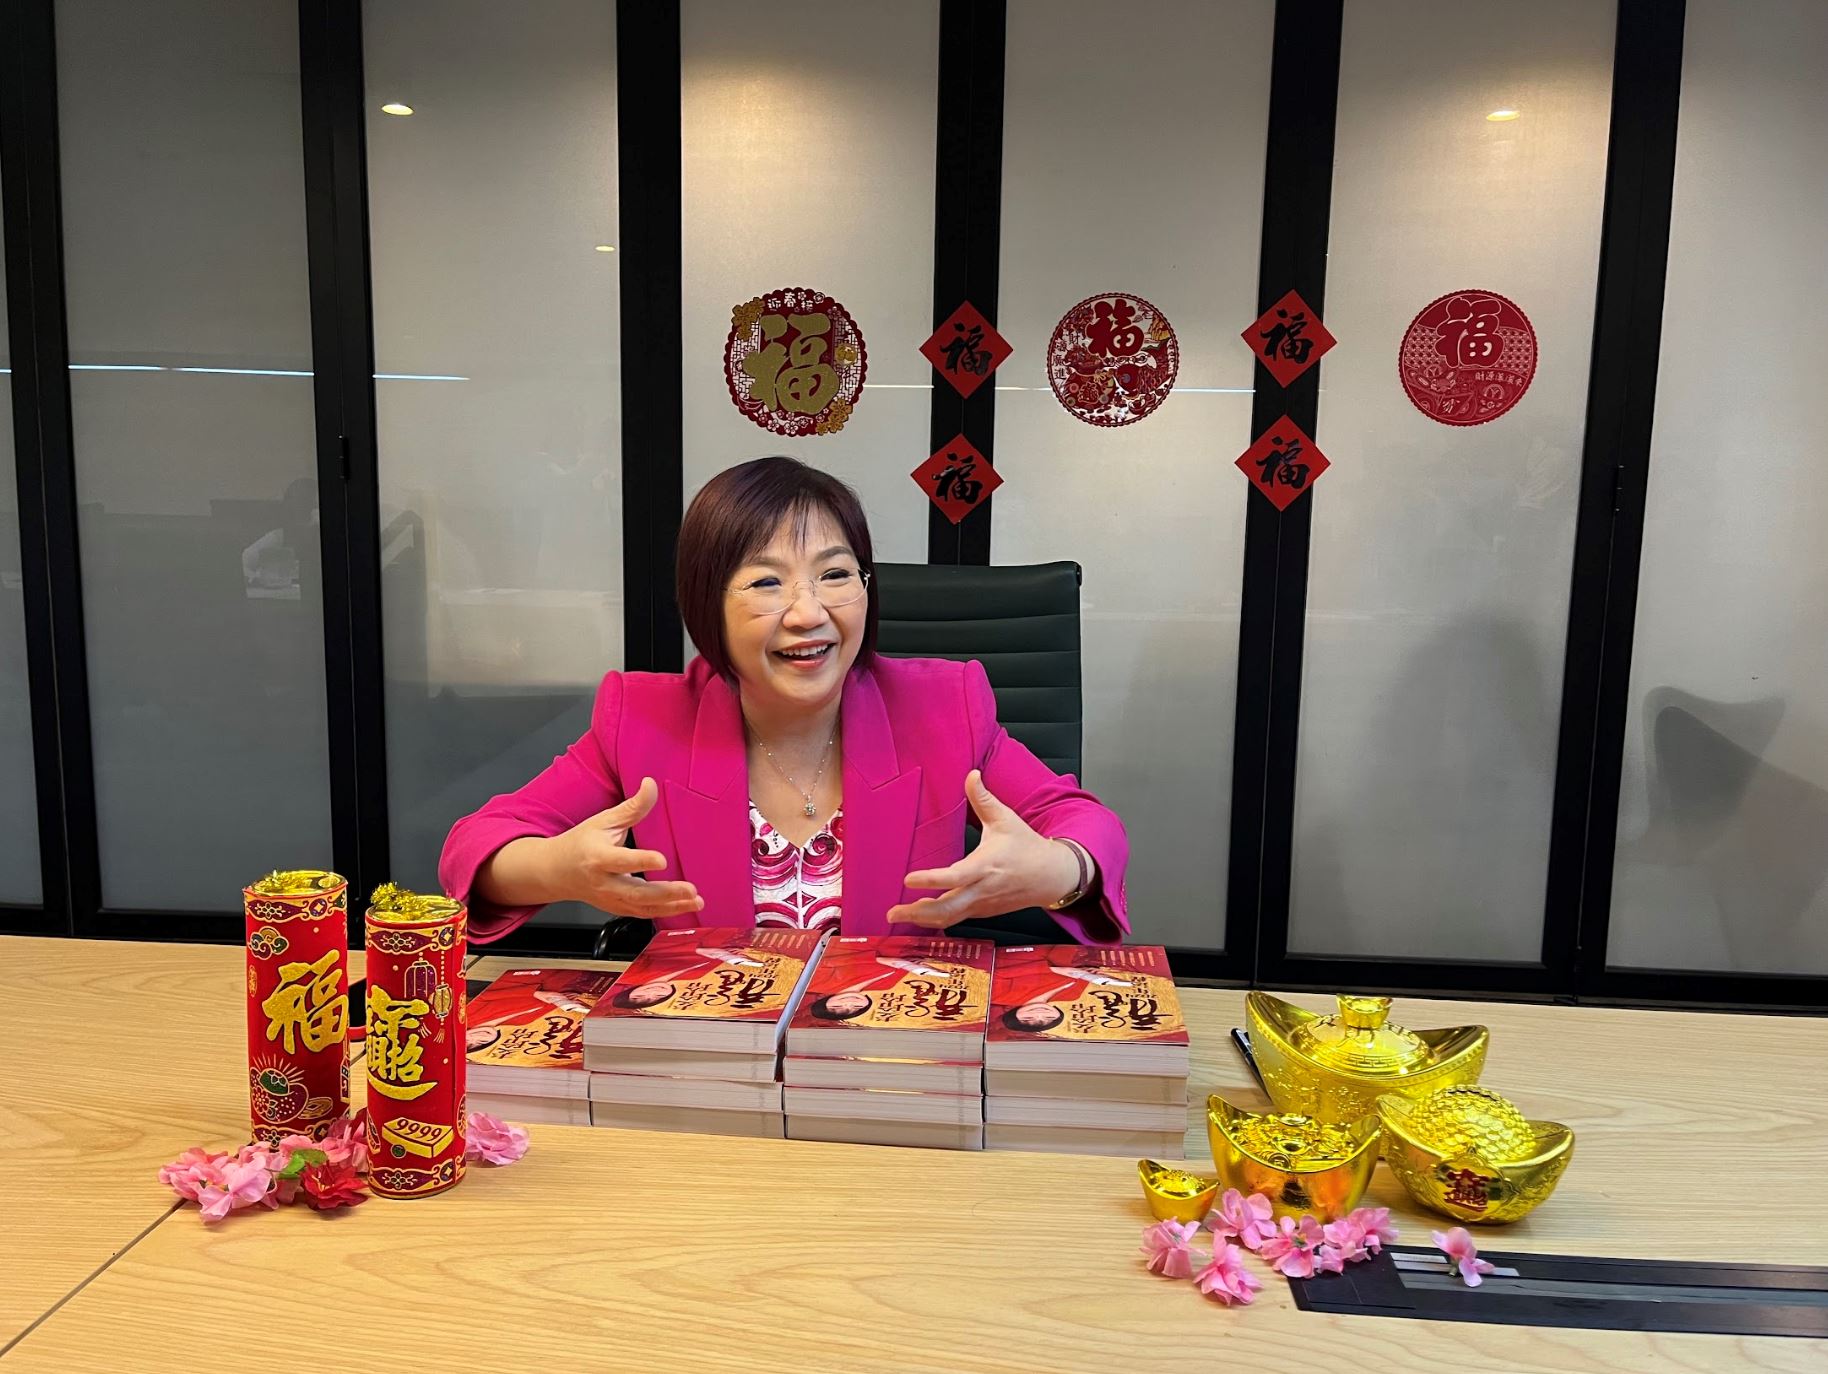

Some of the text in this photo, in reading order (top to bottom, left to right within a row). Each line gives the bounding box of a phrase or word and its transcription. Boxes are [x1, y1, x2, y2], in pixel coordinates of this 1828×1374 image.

[940, 322, 993, 376] 福
[1086, 299, 1144, 358] 福
[1259, 308, 1315, 365] 福
[1434, 297, 1504, 368] 福
[742, 313, 840, 414] 福
[931, 453, 984, 505] 福
[1255, 436, 1311, 489] 福
[262, 949, 349, 1054] 福
[394, 1118, 442, 1141] 9999
